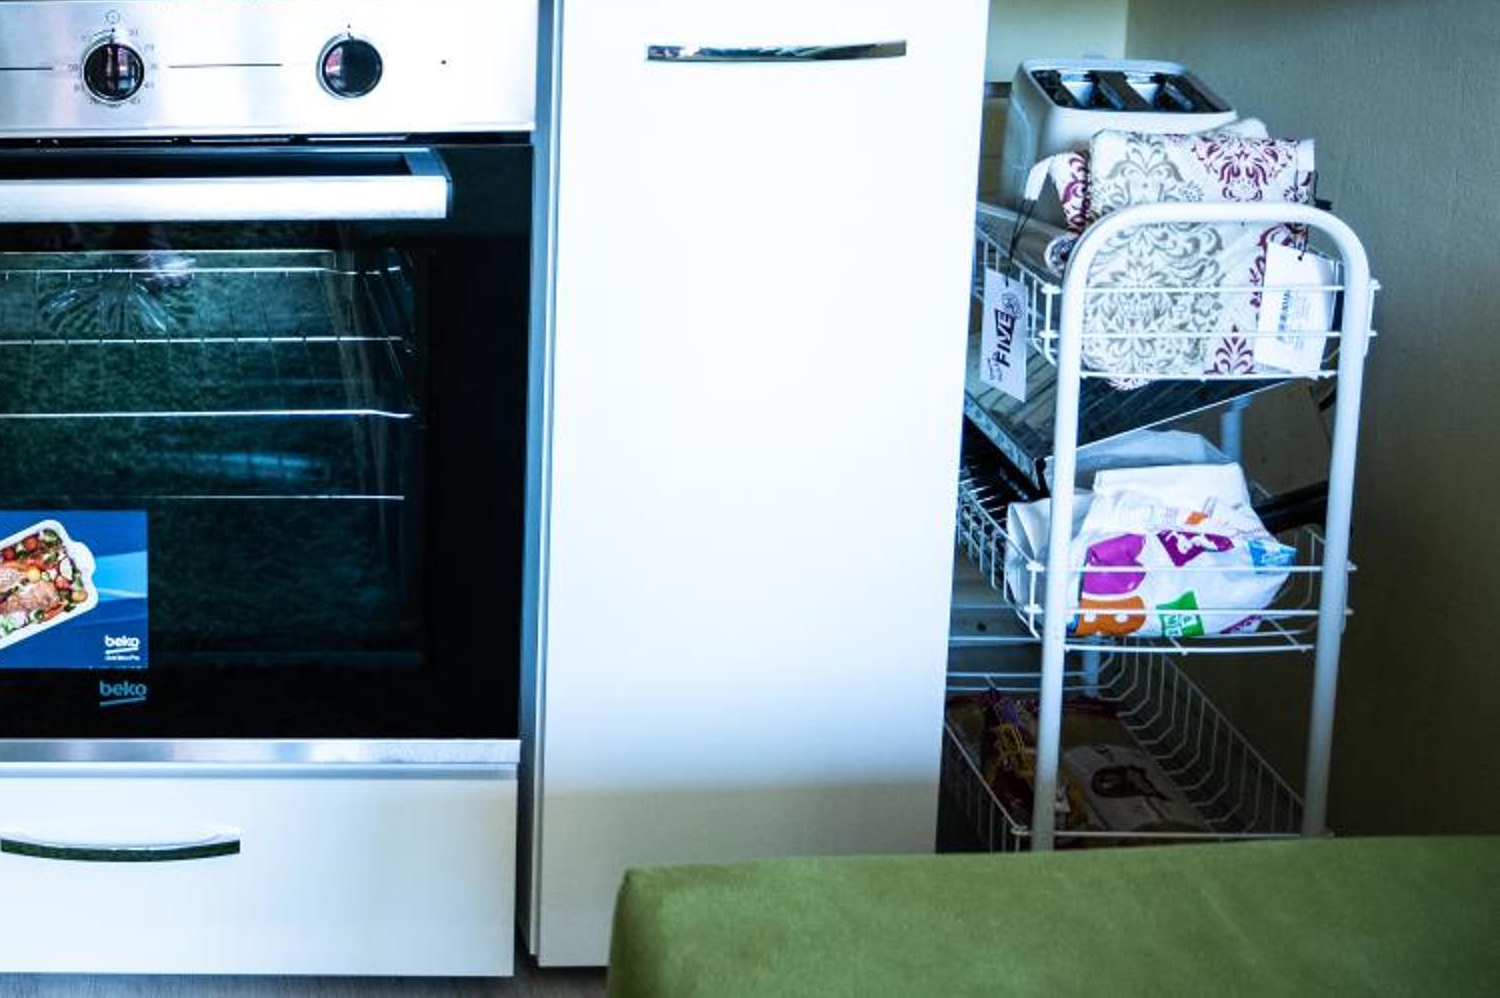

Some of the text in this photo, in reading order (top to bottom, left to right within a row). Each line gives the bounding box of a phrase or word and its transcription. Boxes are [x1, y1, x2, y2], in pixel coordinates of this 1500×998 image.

[994, 308, 1016, 368] FIVE
[104, 634, 141, 648] beko
[100, 680, 148, 697] beko
